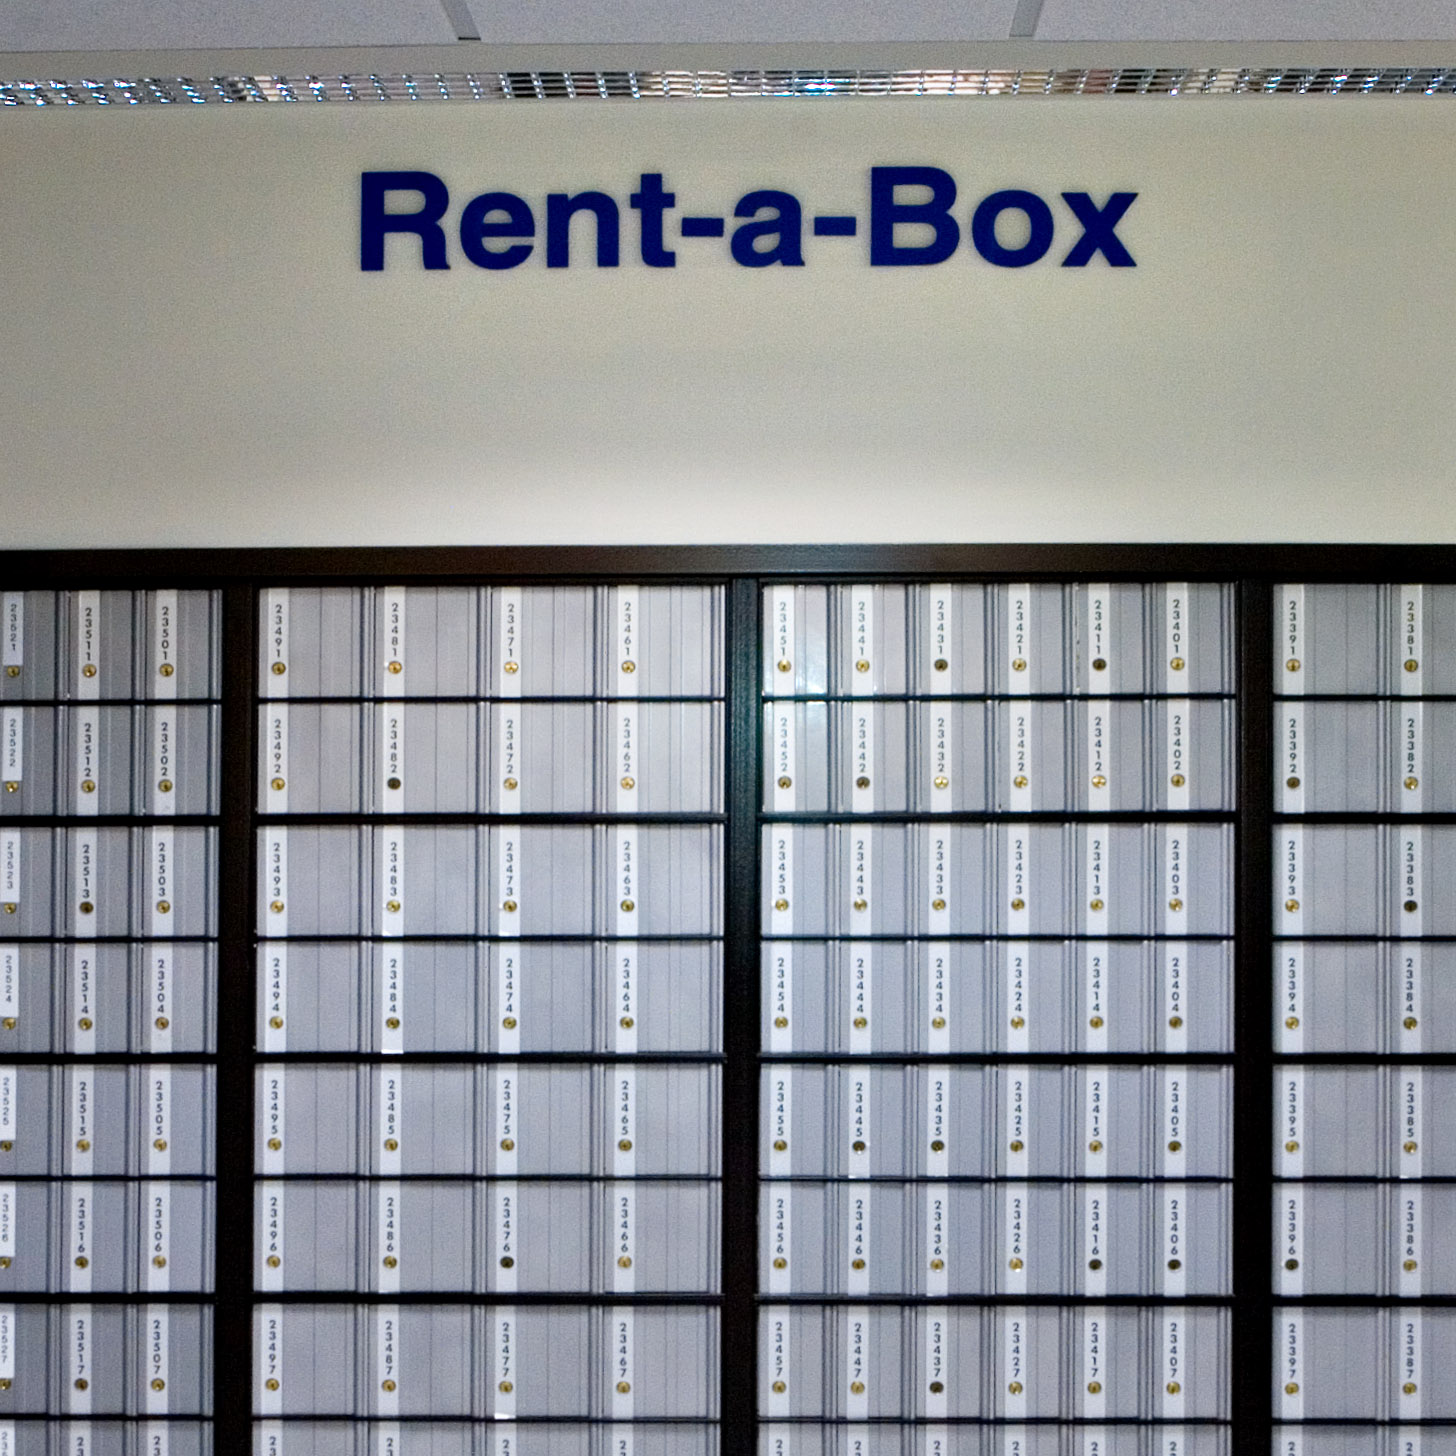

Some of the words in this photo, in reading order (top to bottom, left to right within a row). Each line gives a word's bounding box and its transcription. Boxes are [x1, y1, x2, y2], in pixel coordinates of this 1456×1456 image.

[359, 166, 1140, 271] Rent-a-Box
[82, 607, 93, 661] 23511
[272, 604, 283, 658] 23491
[505, 603, 516, 657] 23471
[779, 602, 790, 657] 23451
[936, 600, 947, 655] 23431
[1092, 600, 1103, 654] 23411
[1287, 600, 1298, 655] 23391
[158, 722, 169, 776] 23502
[387, 719, 398, 773] 23482
[621, 718, 632, 773] 23462
[857, 718, 868, 773] 23442
[1016, 717, 1027, 772] 23422
[1172, 715, 1183, 770] 23402
[1405, 718, 1416, 773] 23382
[81, 844, 92, 898] 23513
[272, 842, 283, 897] 23493
[505, 842, 516, 897] 23473
[777, 840, 788, 895] 23453
[934, 840, 945, 895] 23433
[1092, 840, 1103, 895] 23413
[1287, 840, 1298, 895] 23393
[155, 959, 166, 1013] 23504
[388, 959, 399, 1013] 23484
[621, 958, 632, 1013] 23464
[854, 958, 865, 1013] 23444
[1013, 957, 1024, 1012] 23424
[1170, 957, 1181, 1012] 23404
[1404, 958, 1415, 1013] 23384
[78, 1081, 89, 1136] 23515
[269, 1080, 280, 1135] 23495
[501, 1080, 512, 1134] 23475
[775, 1081, 786, 1136] 23455
[932, 1081, 943, 1136] 23435
[1090, 1081, 1101, 1137] 23415
[1287, 1081, 1298, 1137] 23395
[153, 1197, 164, 1252] 23506
[385, 1197, 396, 1252] 23486
[619, 1197, 630, 1253] 23466
[853, 1199, 864, 1255] 23446
[1012, 1199, 1023, 1254] 23426
[1169, 1200, 1180, 1255] 23406
[1404, 1200, 1415, 1256] 23386
[75, 1320, 86, 1374] 23517
[267, 1320, 278, 1374] 23497
[501, 1322, 512, 1377] 23477
[774, 1322, 785, 1377] 23457
[932, 1322, 943, 1377] 23437
[1089, 1322, 1100, 1377] 23417
[1286, 1323, 1297, 1379] 23397
